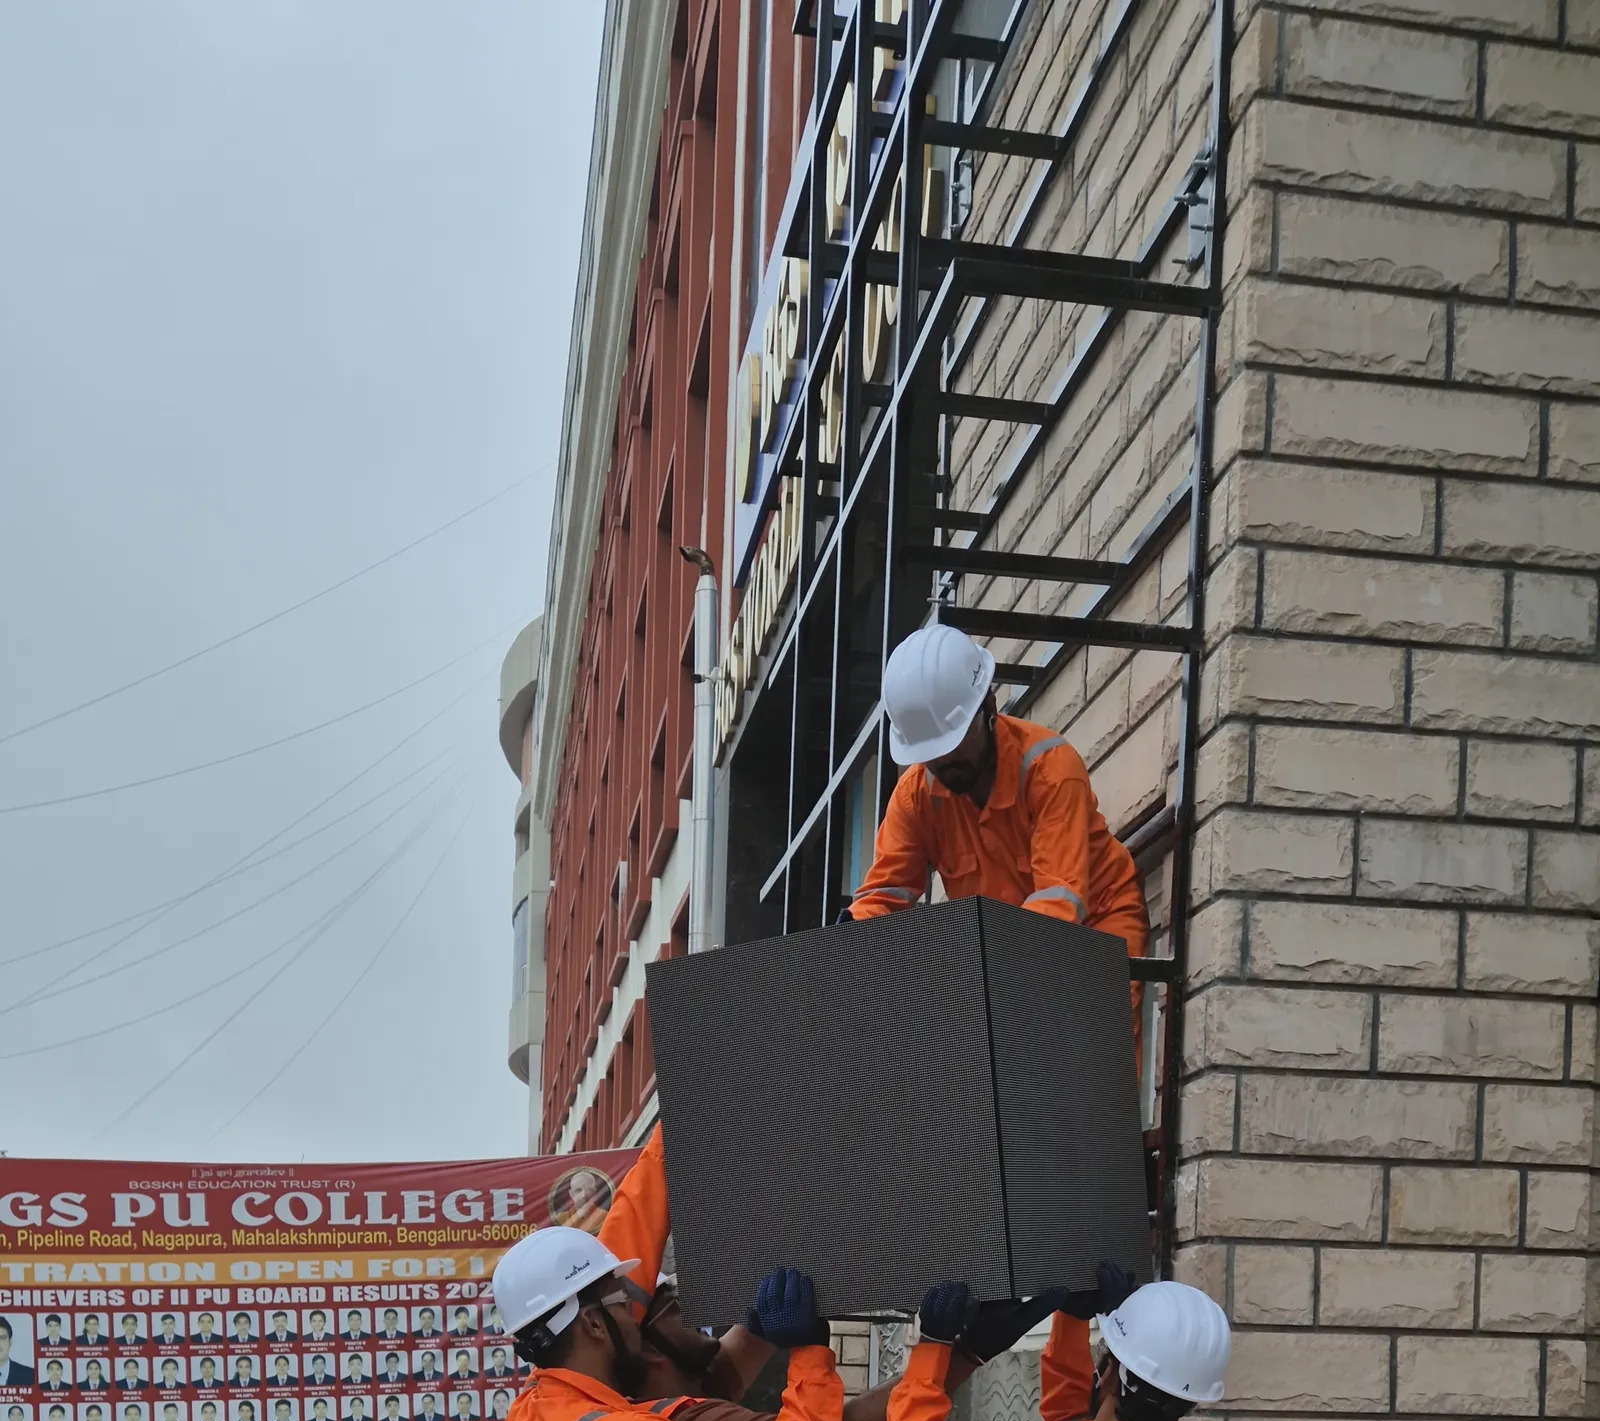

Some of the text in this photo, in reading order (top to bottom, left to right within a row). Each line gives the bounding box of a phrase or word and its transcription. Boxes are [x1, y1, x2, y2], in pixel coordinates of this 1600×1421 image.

[129, 1180, 356, 1190] BGSKH EDUCATION TRUST (R)
[111, 1192, 210, 1227] PU
[231, 1188, 524, 1228] COLLEGE
[17, 1229, 85, 1251] Pipeline
[90, 1229, 138, 1250] Road,
[142, 1229, 228, 1251] Nagapura,
[232, 1228, 393, 1248] Mahalakshmipuram,
[1, 1261, 216, 1283] TRATION
[230, 1259, 354, 1281] OPEN
[368, 1257, 456, 1279] FOR
[0, 1280, 493, 1307] CHIEVERS OF II PU BOARD RESULTS 202
